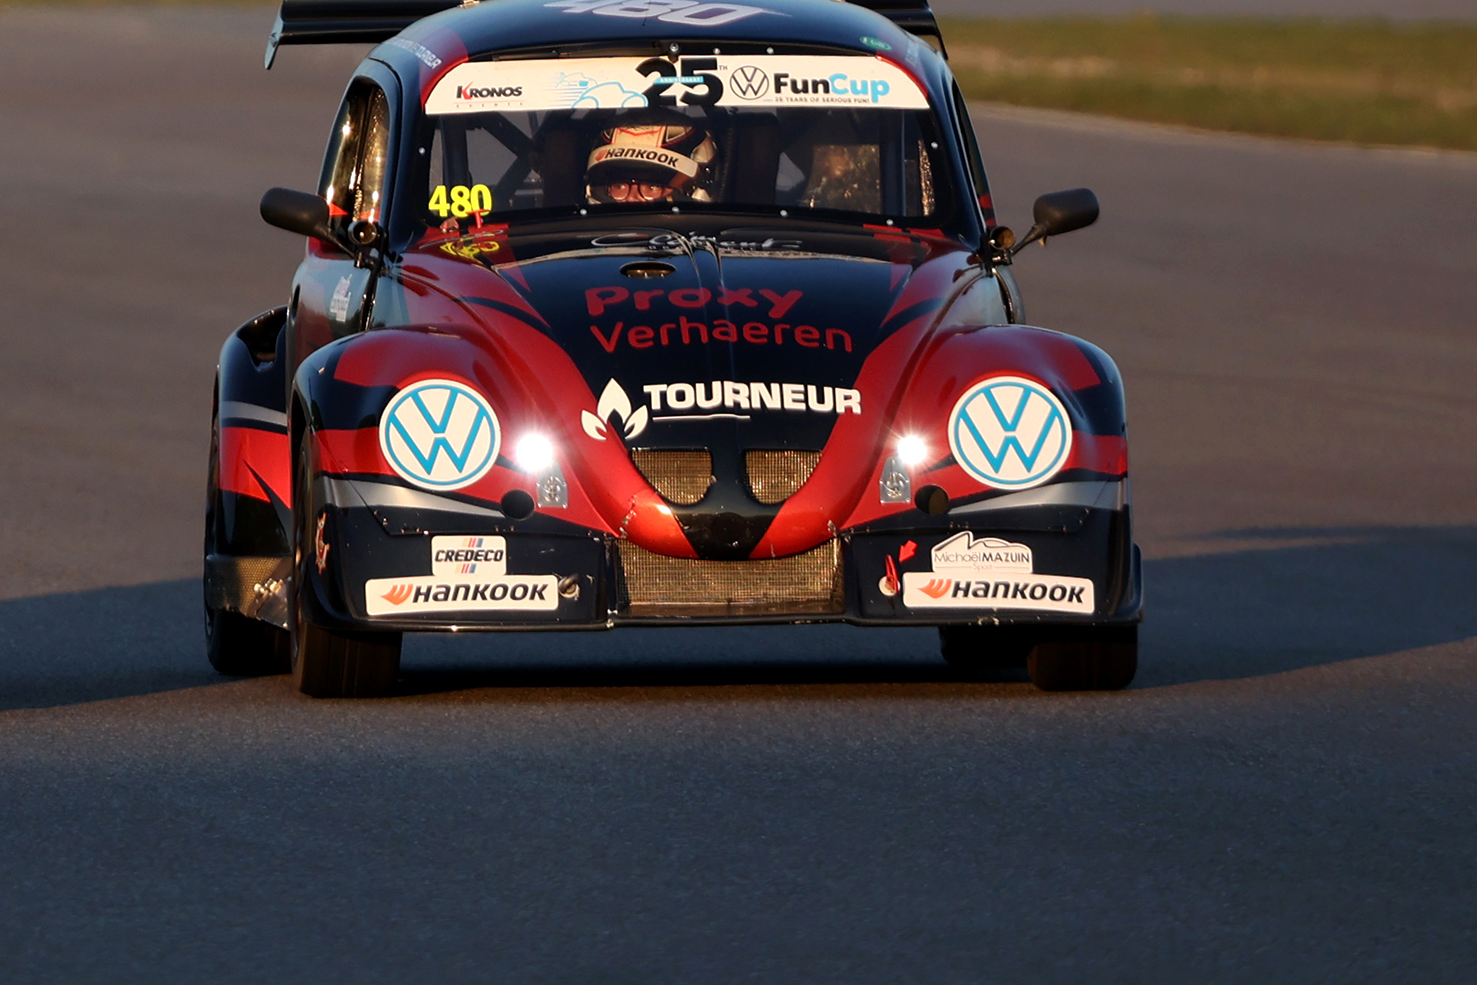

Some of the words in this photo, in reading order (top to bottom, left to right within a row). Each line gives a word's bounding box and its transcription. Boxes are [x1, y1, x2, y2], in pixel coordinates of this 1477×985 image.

[456, 81, 523, 100] KRONOS
[635, 57, 723, 107] 25
[774, 73, 890, 103] FunCup
[428, 184, 492, 217] 480
[584, 286, 803, 319] Proxy
[590, 316, 853, 353] Verhaeren
[643, 380, 862, 415] TOURNEUR
[435, 549, 504, 562] CREDECO
